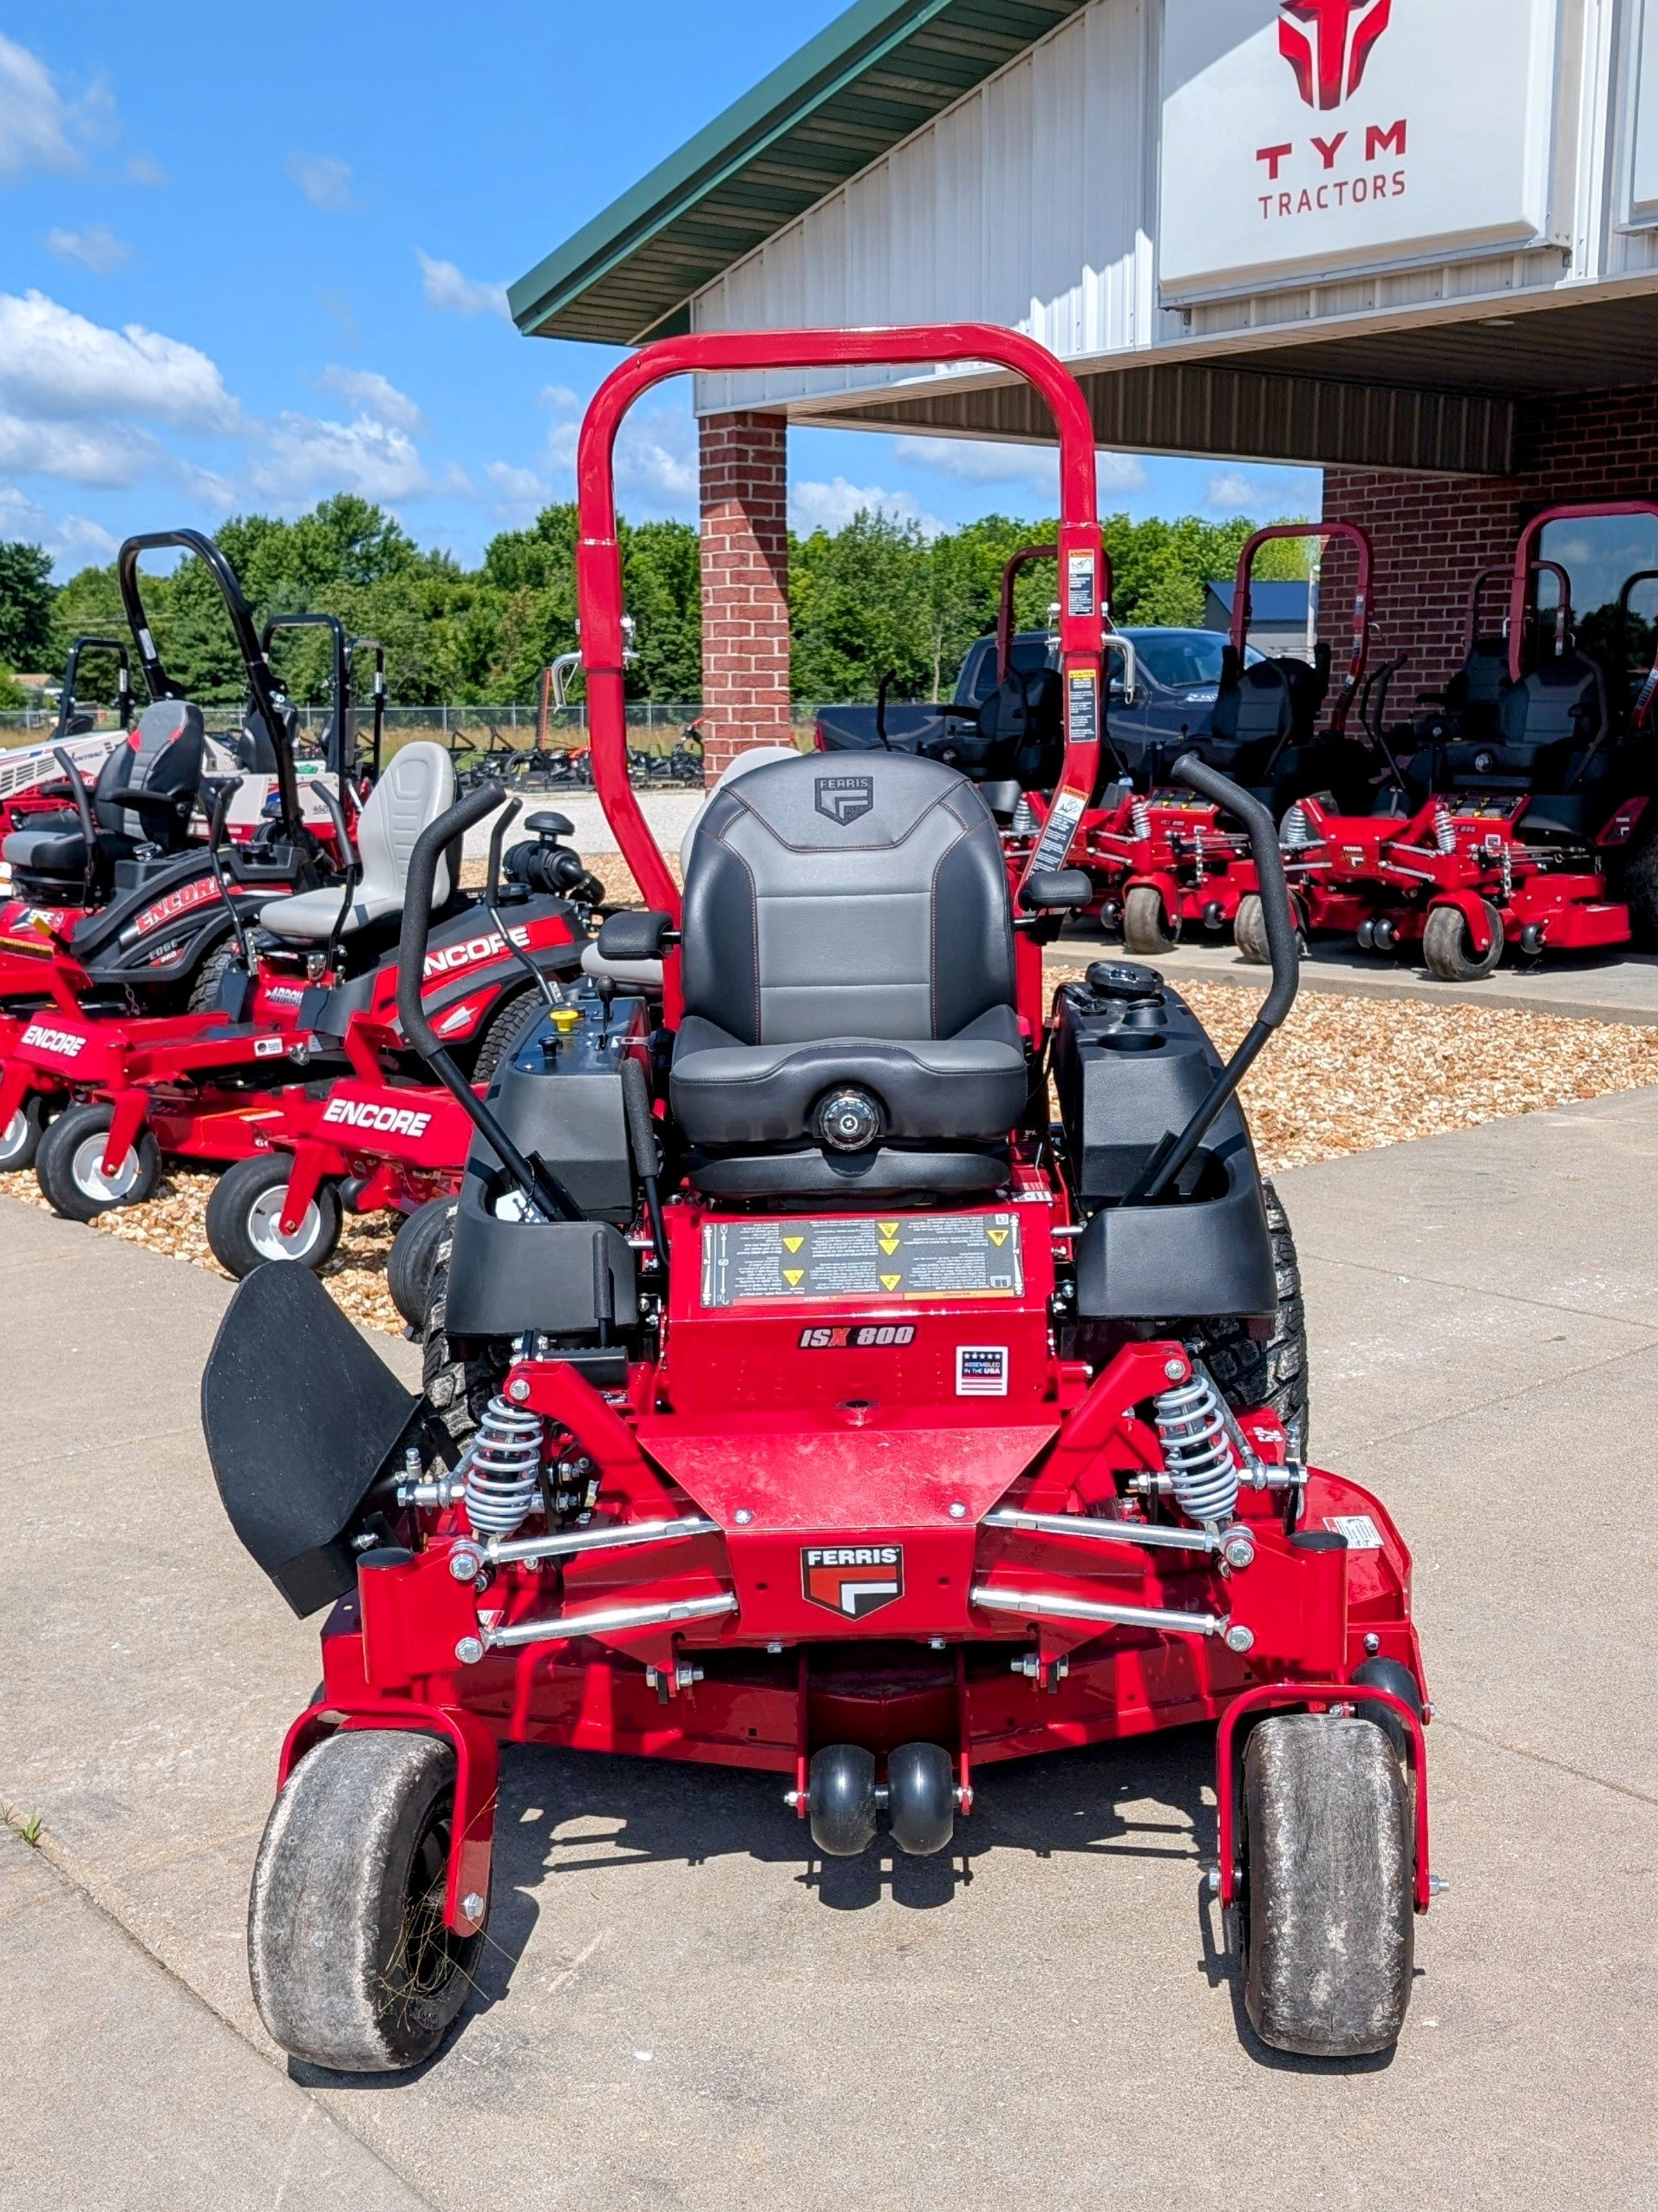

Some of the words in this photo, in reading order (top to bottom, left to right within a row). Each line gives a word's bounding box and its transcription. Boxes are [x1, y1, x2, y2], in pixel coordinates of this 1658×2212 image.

[1256, 119, 1407, 179] TYM
[1258, 170, 1406, 219] TRACTORS
[819, 779, 869, 789] FERRIS
[424, 926, 530, 977] NCORE
[21, 1024, 87, 1057] ENCORE
[323, 1098, 432, 1138] ENCORE
[800, 1328, 851, 1347] ISX
[857, 1326, 914, 1346] 800
[807, 1548, 898, 1566] FERRIS
